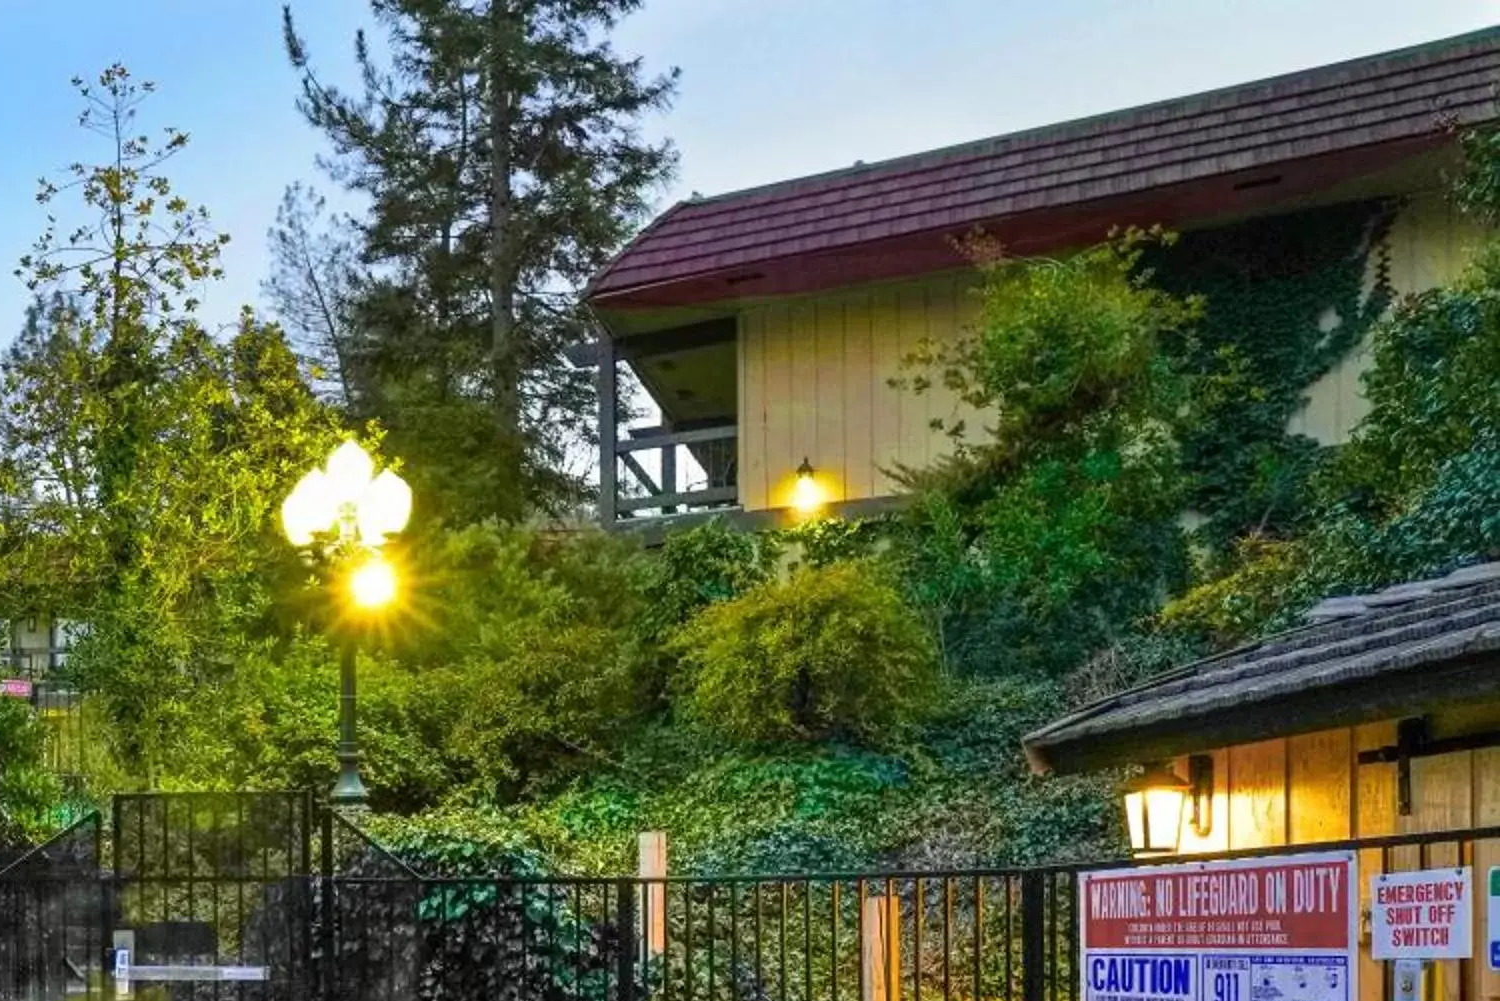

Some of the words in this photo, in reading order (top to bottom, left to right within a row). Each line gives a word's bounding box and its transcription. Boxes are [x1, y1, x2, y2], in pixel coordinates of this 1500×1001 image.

[1091, 880, 1151, 920] WARNING:
[1155, 877, 1173, 917] NO
[1179, 871, 1259, 917] LIFEGUARD
[1265, 870, 1287, 914] ON
[1293, 866, 1341, 913] DUTY
[1377, 882, 1464, 904] EMERGENCY
[1386, 907, 1422, 926] SHUT
[1429, 905, 1455, 924] OFF
[1392, 927, 1449, 947] SWITCH
[1093, 958, 1189, 995] CAUTION
